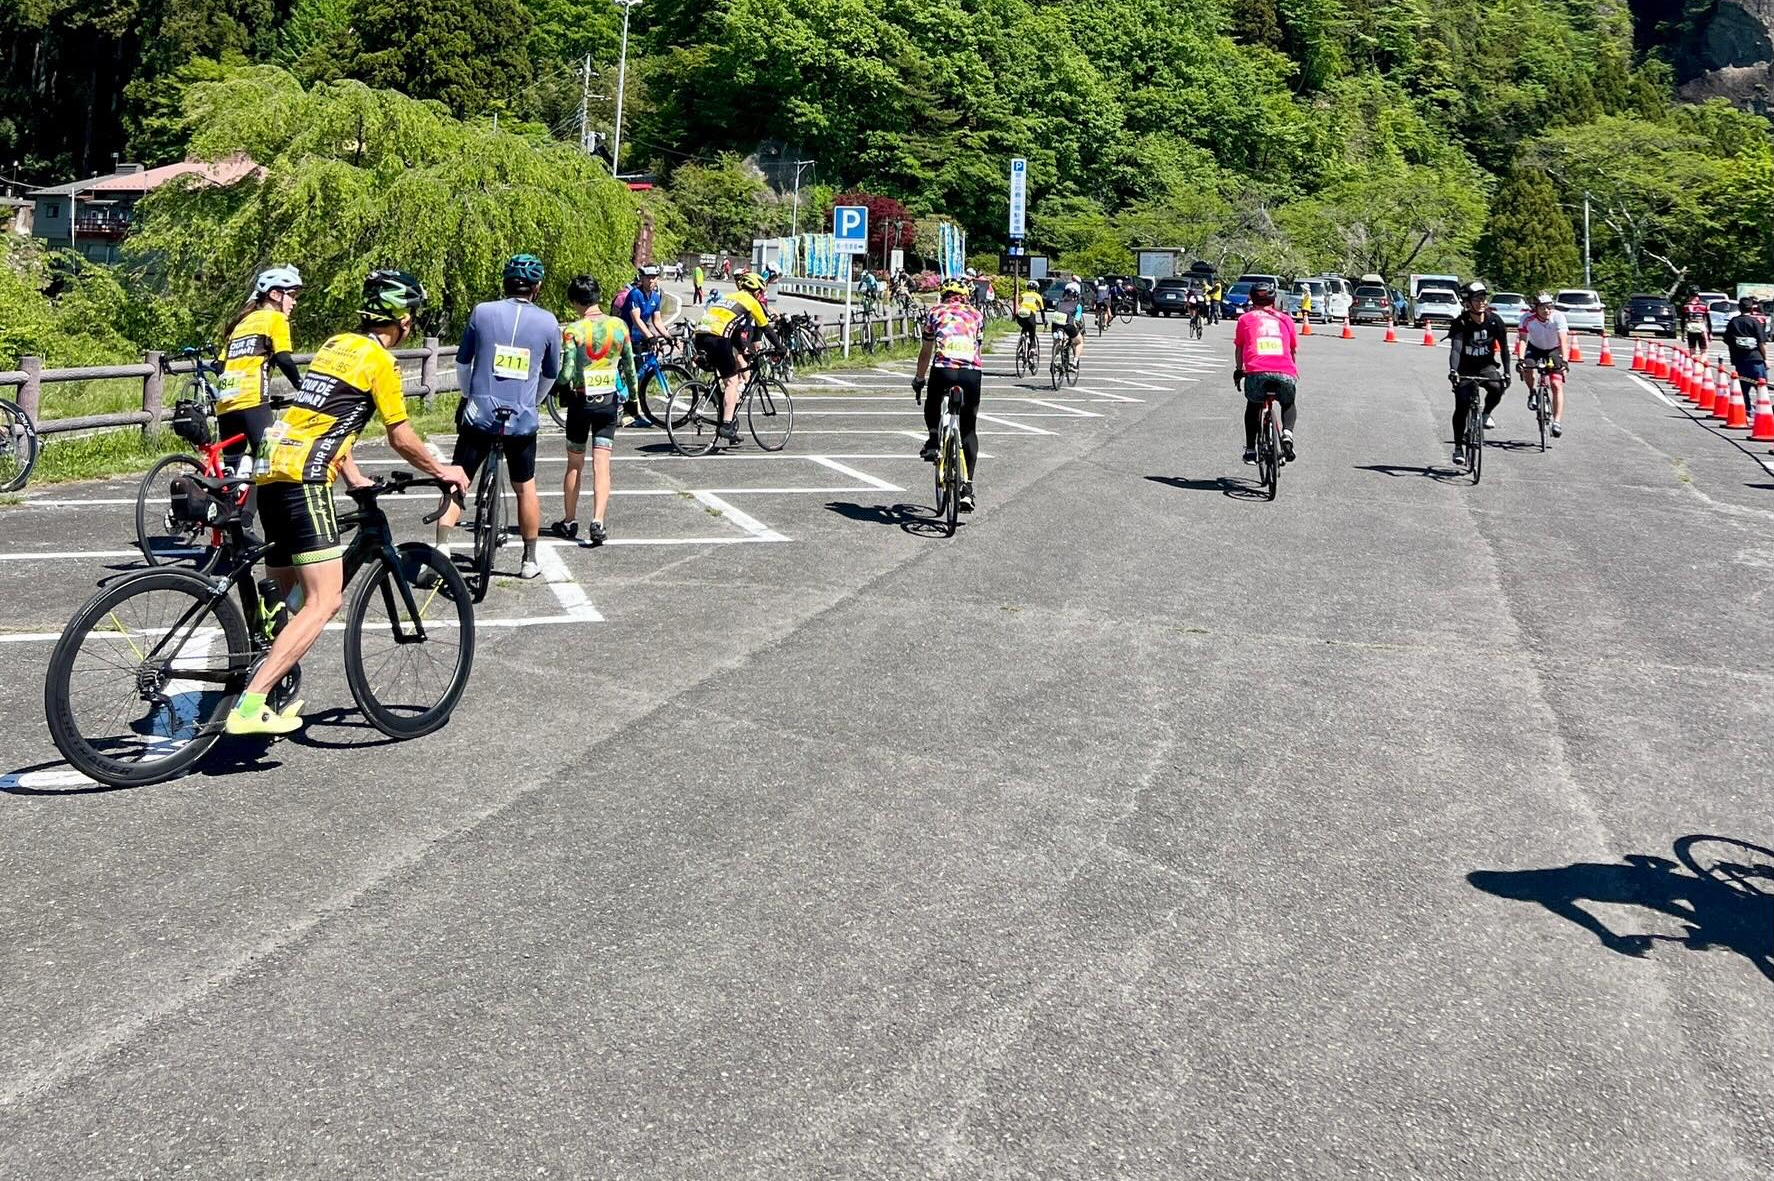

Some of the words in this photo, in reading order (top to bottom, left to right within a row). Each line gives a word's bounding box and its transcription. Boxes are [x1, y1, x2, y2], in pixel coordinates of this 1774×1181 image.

[842, 209, 861, 237] P
[230, 340, 245, 350] OUR
[495, 354, 522, 370] 211
[301, 379, 319, 392] OUR
[316, 382, 335, 397] DE
[586, 375, 610, 387] 294
[320, 437, 336, 451] DE
